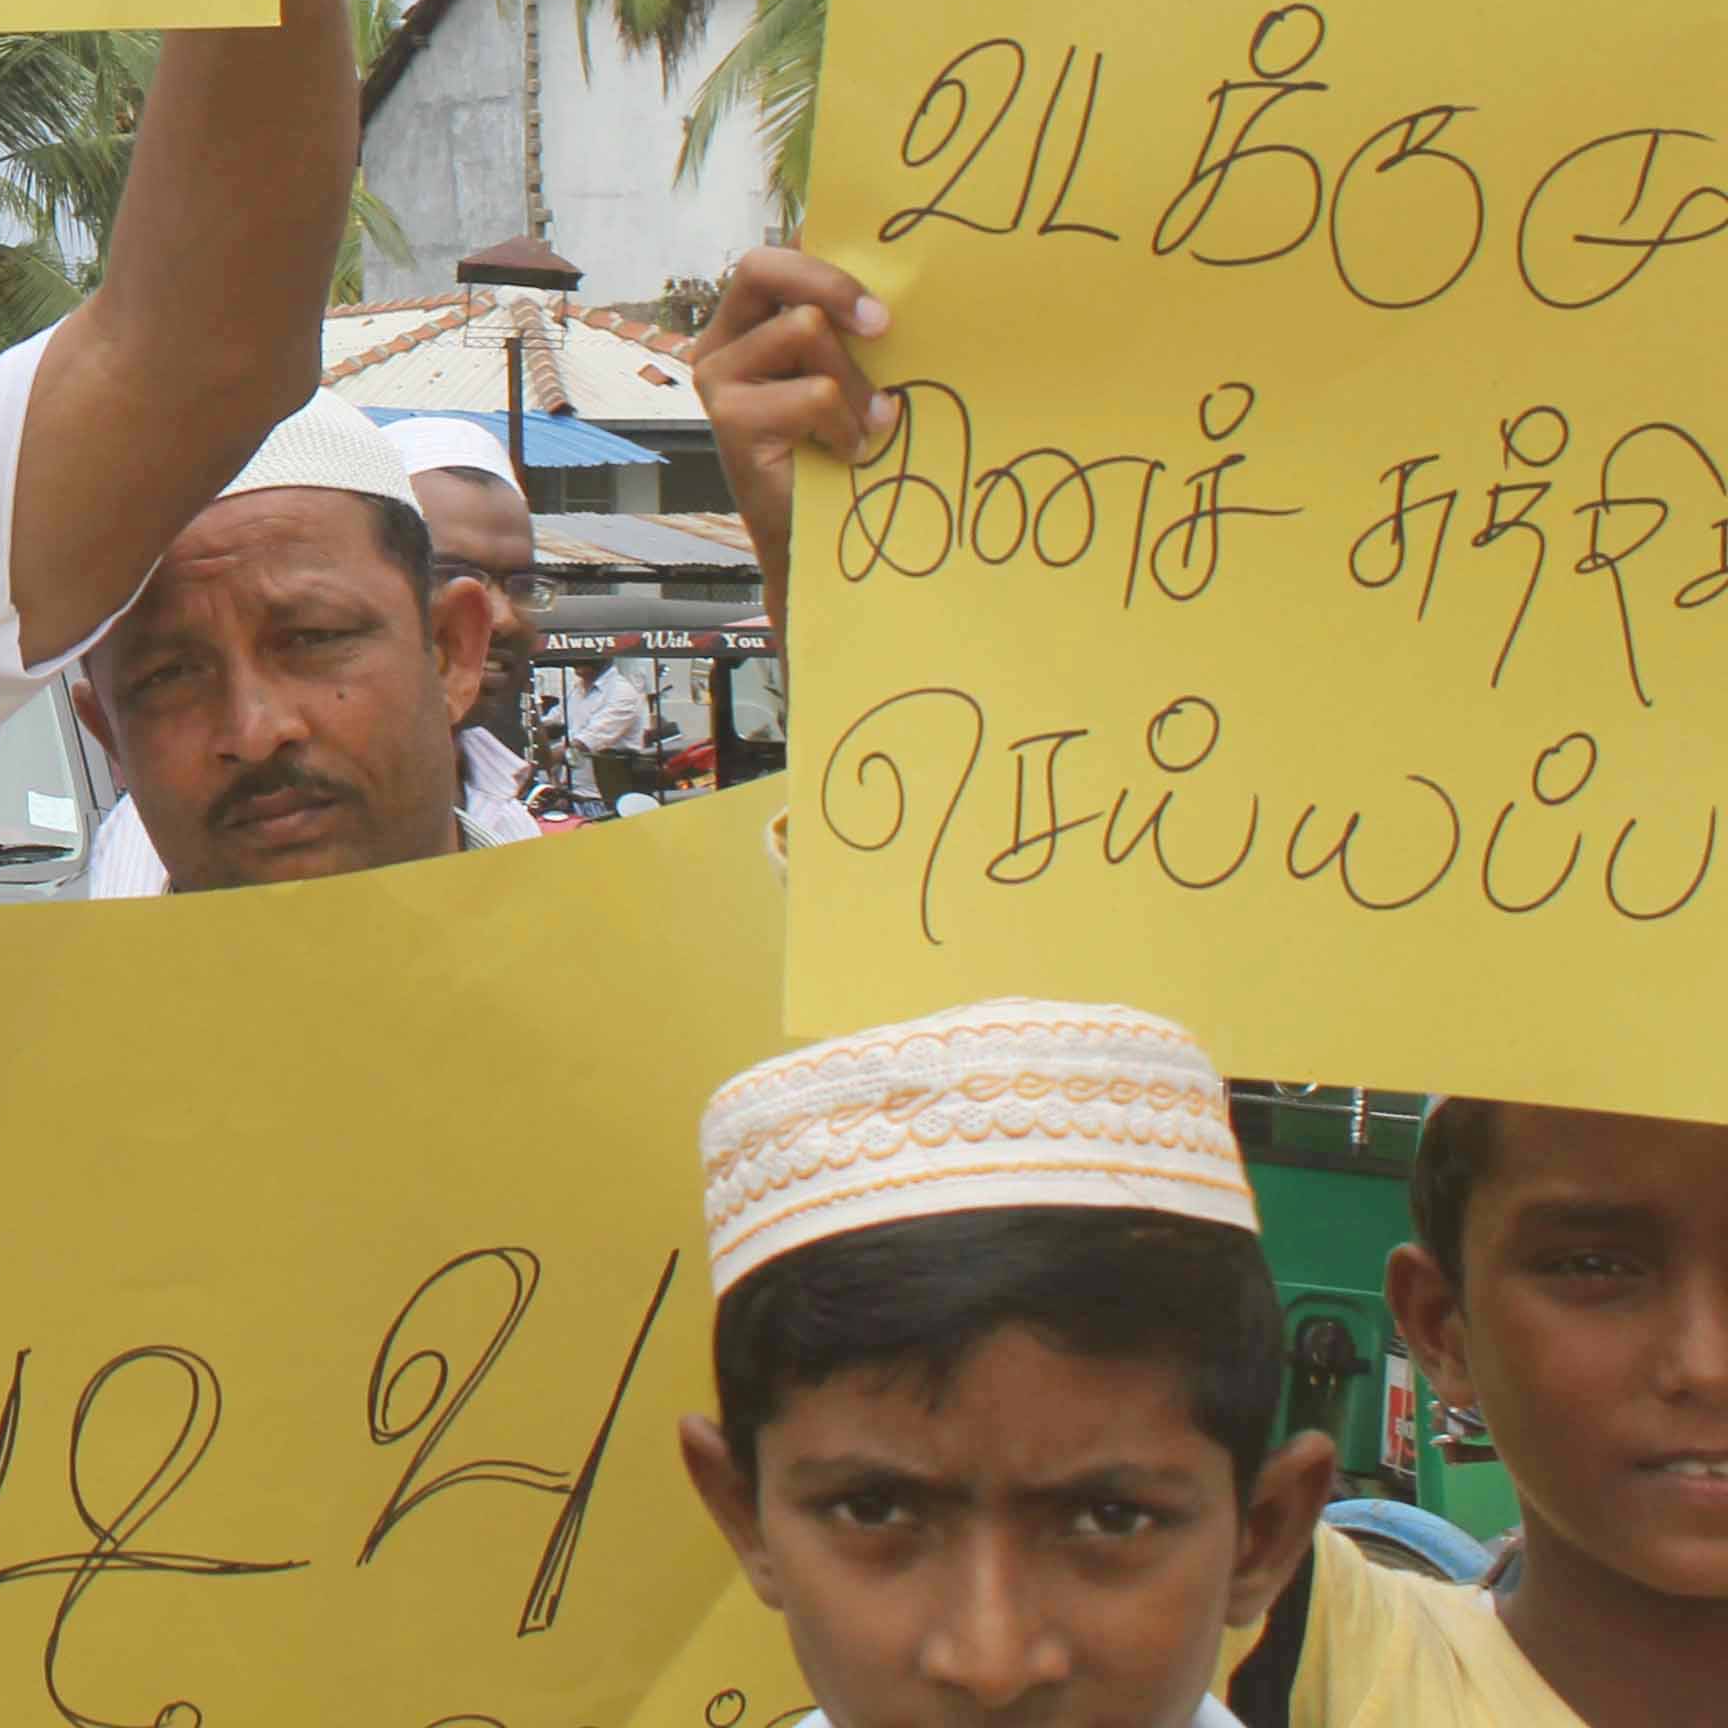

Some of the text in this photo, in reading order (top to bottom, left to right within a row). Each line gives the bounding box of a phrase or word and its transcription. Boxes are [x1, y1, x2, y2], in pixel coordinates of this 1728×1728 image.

[546, 630, 766, 653] Always With You
